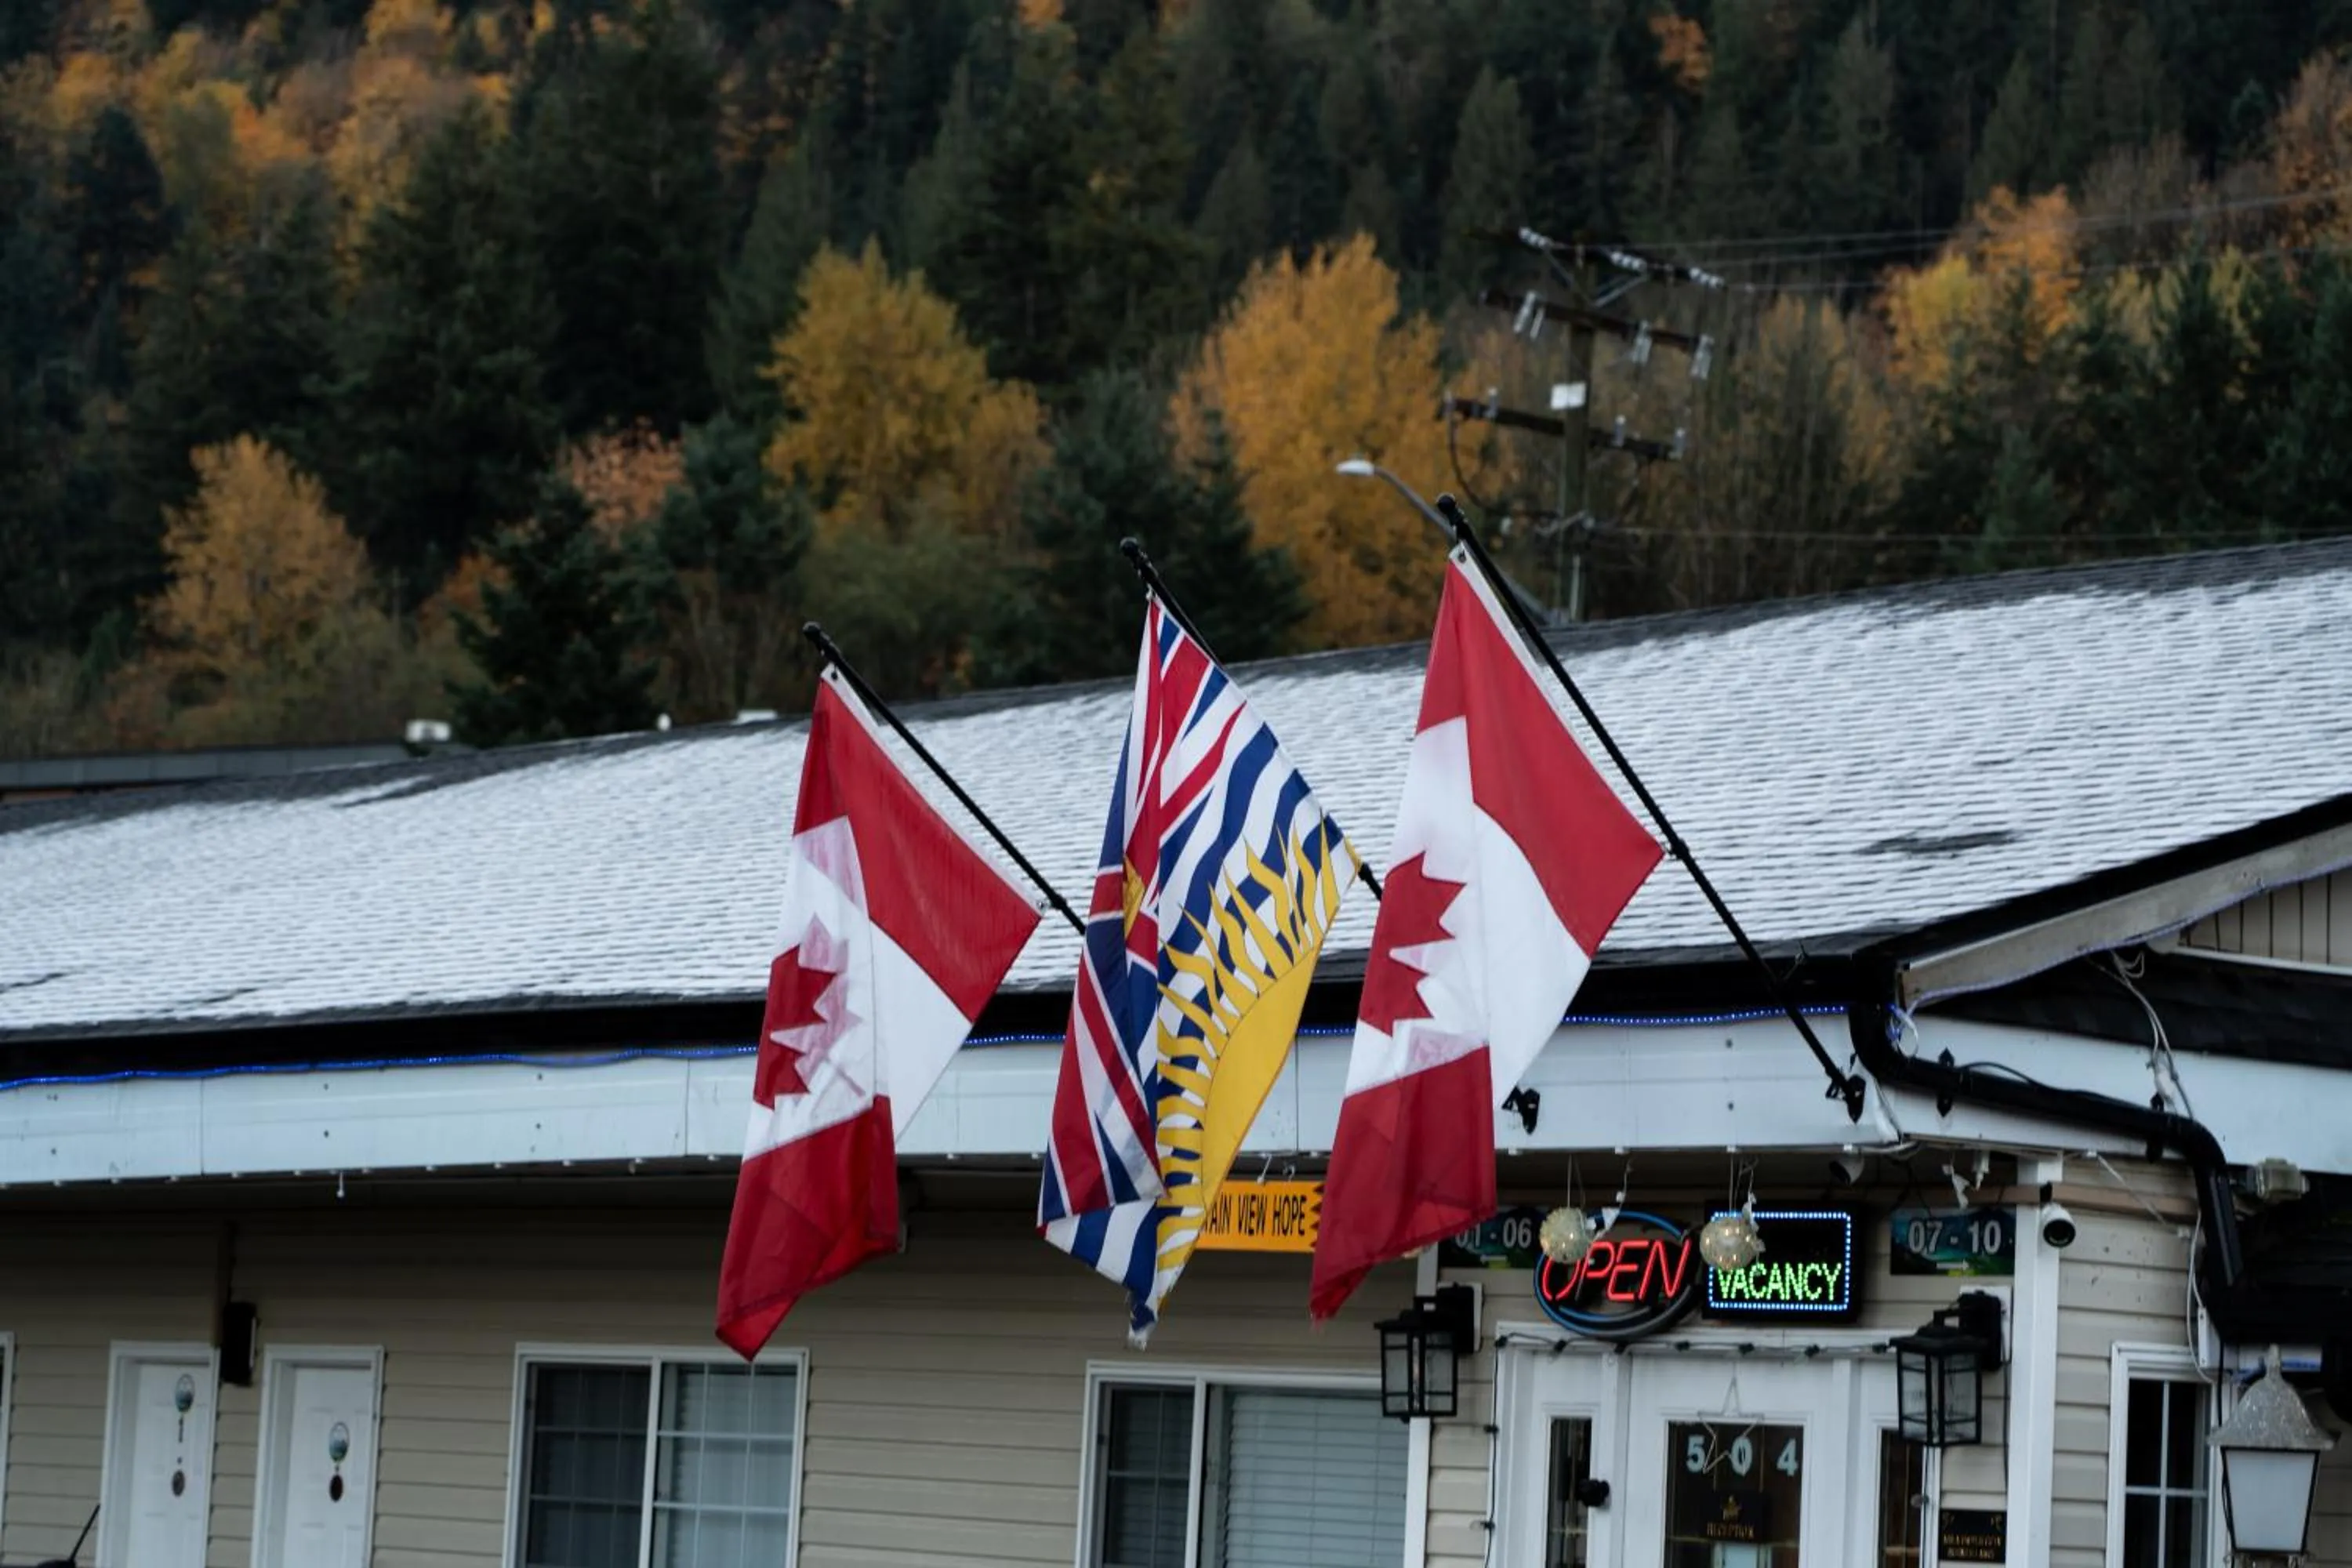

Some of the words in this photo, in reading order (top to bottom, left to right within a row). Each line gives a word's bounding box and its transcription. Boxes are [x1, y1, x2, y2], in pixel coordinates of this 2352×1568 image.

[1204, 1192, 1232, 1236] AIN
[1237, 1194, 1268, 1236] VIEW
[1272, 1195, 1307, 1237] HOPE
[1503, 1217, 1533, 1249] 06
[1908, 1220, 1944, 1254] 07
[1968, 1220, 2002, 1254] 10
[1542, 1237, 1692, 1301] OPEN
[1717, 1262, 1842, 1301] VACANCY
